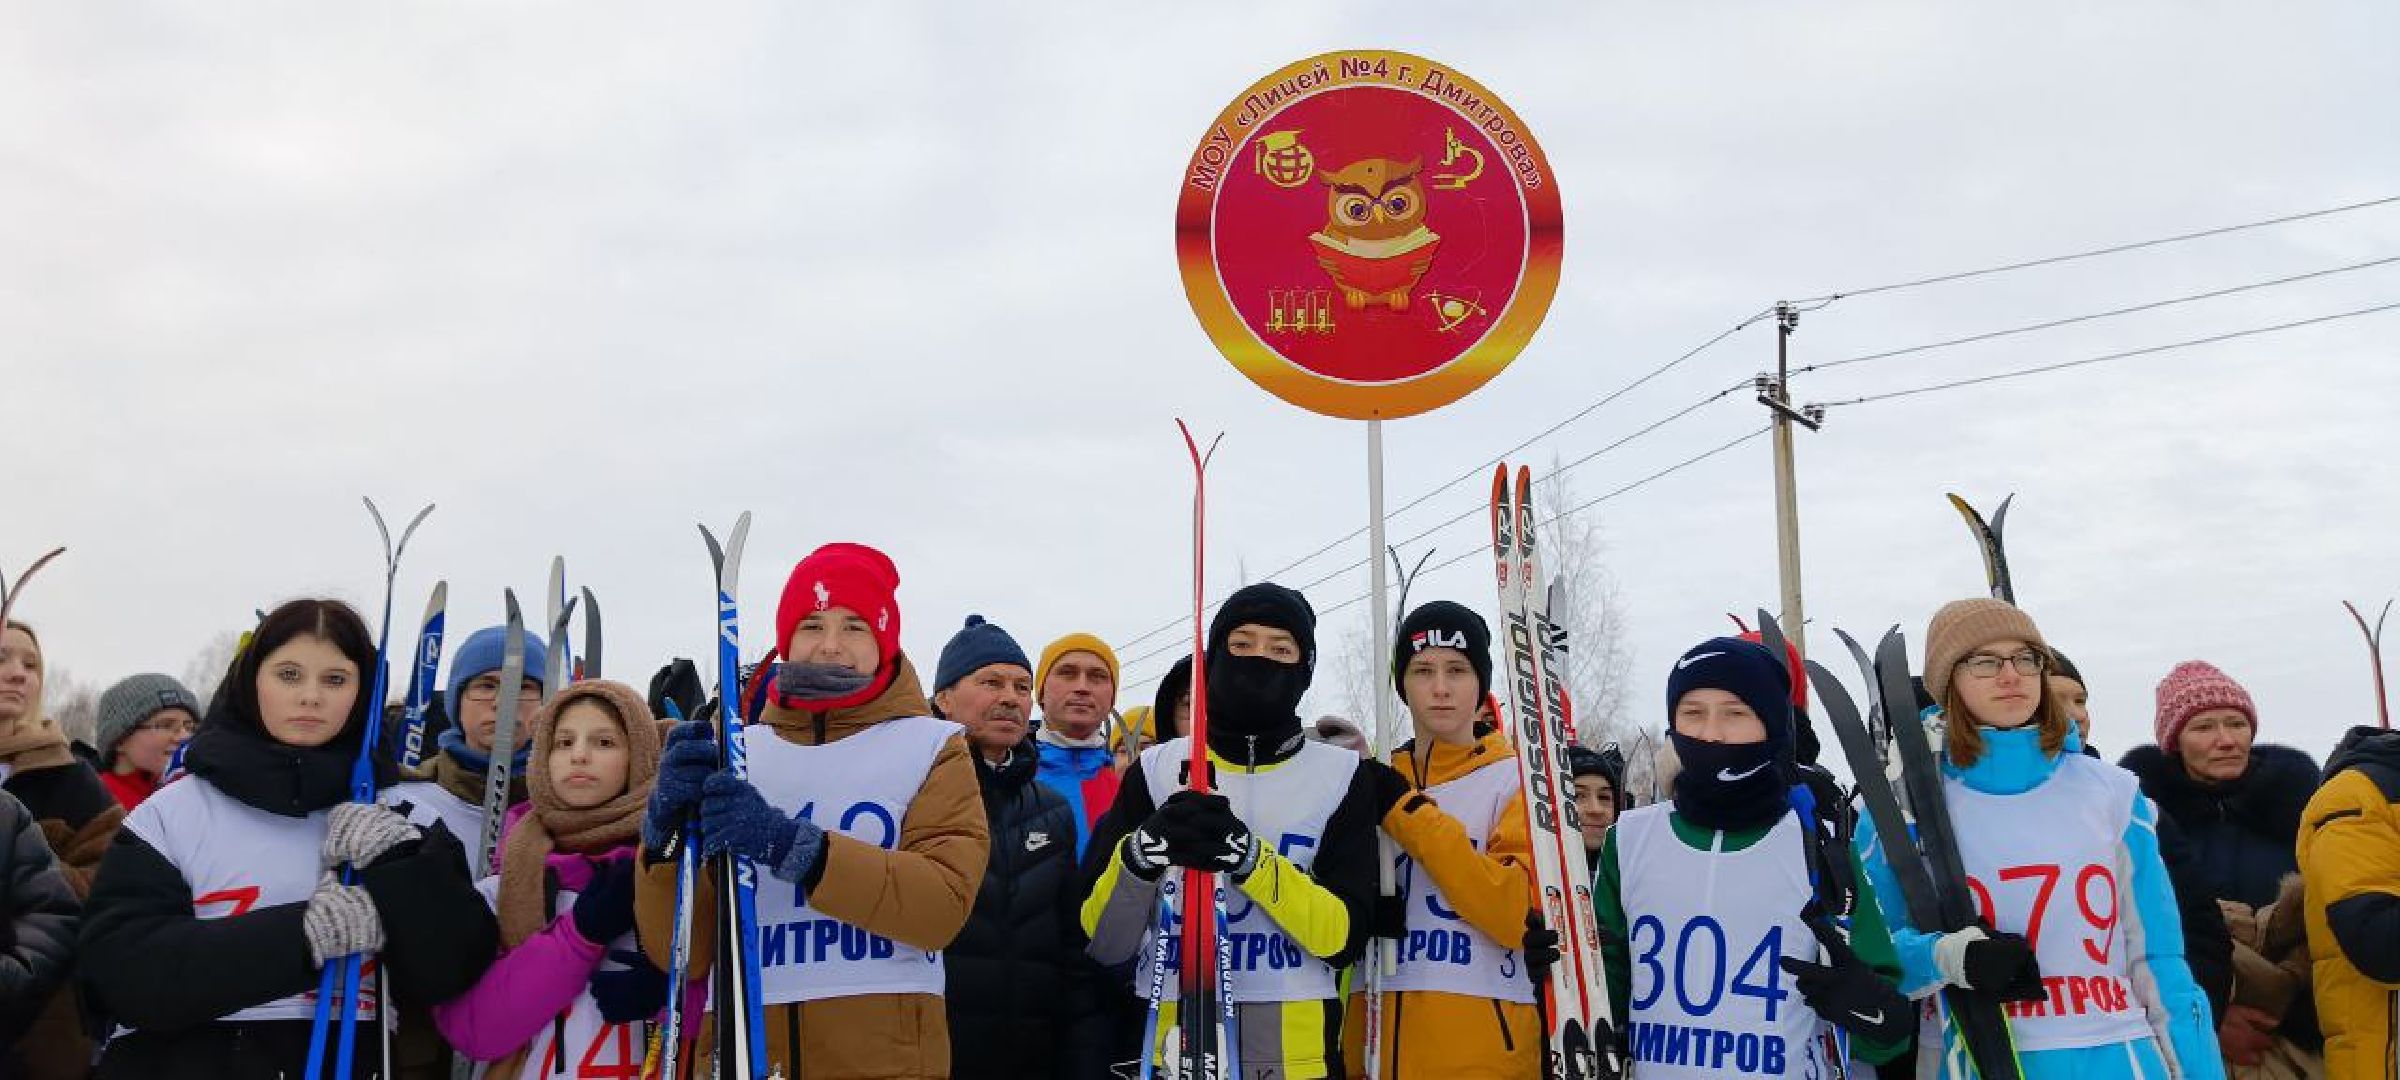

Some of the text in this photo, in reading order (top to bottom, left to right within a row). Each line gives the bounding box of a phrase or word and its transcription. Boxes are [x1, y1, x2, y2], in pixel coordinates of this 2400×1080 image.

[1191, 56, 1541, 191] МОУ «Лицей №4 г. Дмитрова»
[1411, 628, 1467, 652] FILA
[1508, 612, 1557, 835] ROSSIGNOL
[758, 919, 895, 968] ИТРОВ
[1150, 927, 1169, 1010] NORDWAY
[1218, 935, 1235, 1017] NORDWAY
[1629, 914, 1788, 1022] 304
